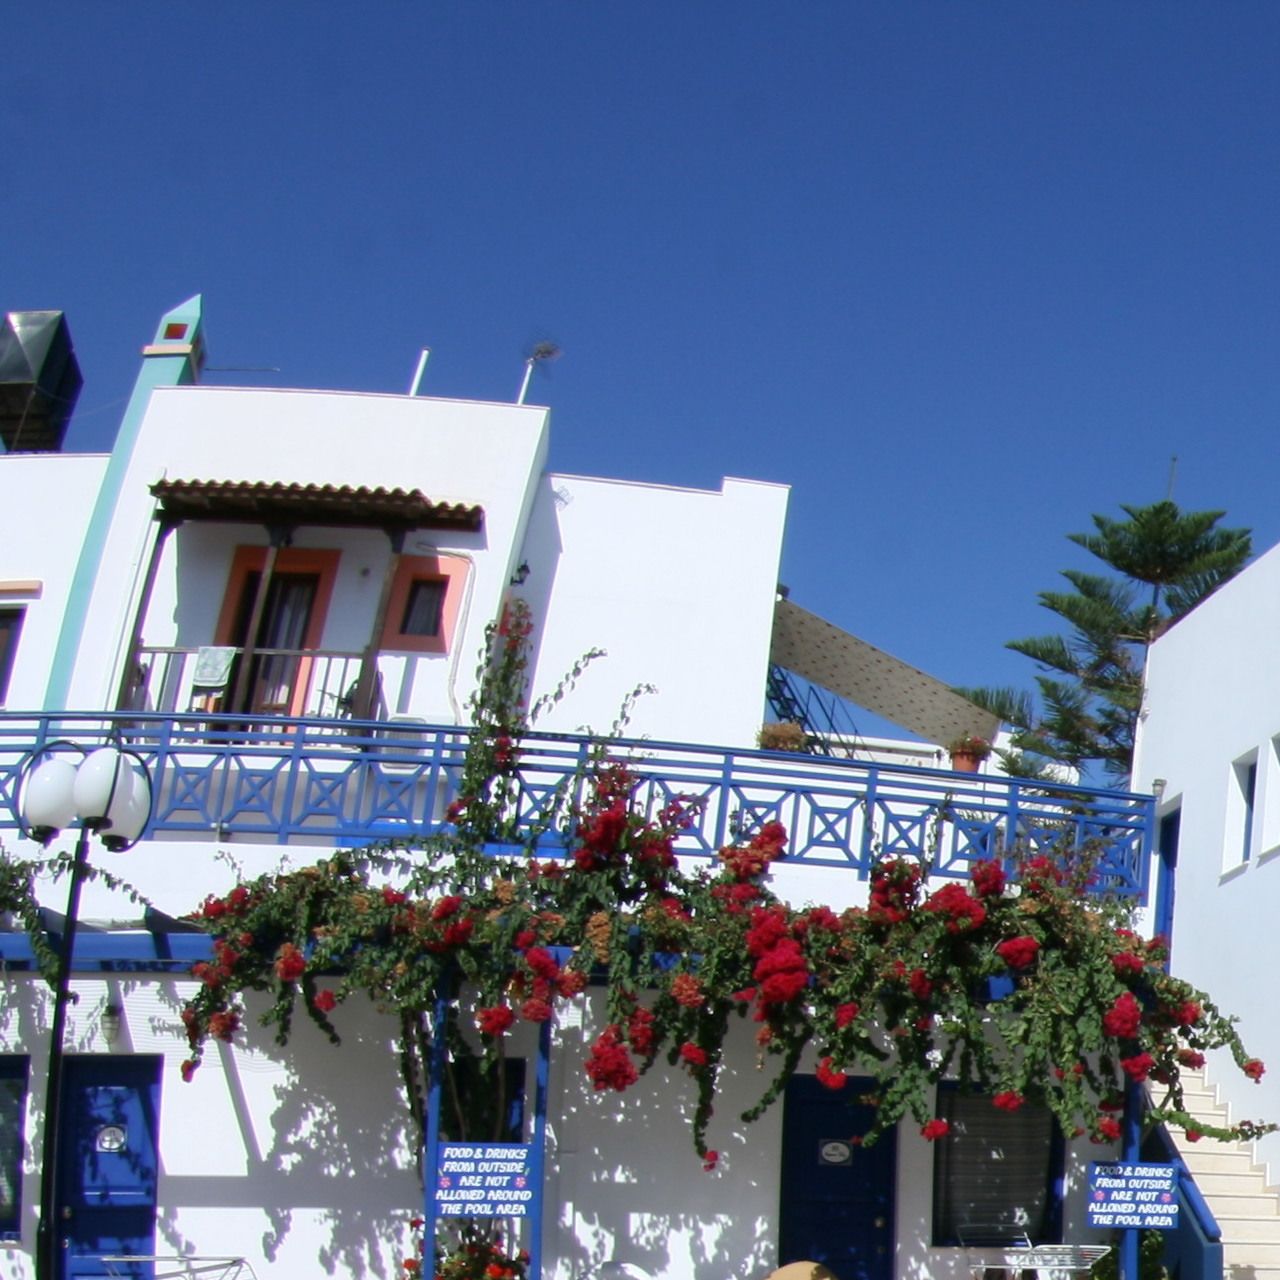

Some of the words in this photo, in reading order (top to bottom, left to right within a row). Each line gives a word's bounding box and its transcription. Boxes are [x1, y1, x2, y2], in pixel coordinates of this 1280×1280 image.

[444, 1147, 473, 1158] FOOD
[473, 1148, 482, 1158] &
[486, 1148, 527, 1159] DRINKS
[444, 1161, 474, 1172] FROM
[478, 1162, 524, 1172] OUTSIDE
[1123, 1166, 1132, 1176] &
[1135, 1167, 1173, 1177] DRINKS
[460, 1175, 482, 1186] ARE
[485, 1176, 510, 1186] NOT
[1096, 1177, 1125, 1188] FROM
[1129, 1179, 1171, 1189] OUTSIDE
[436, 1189, 485, 1200] ALLOWED
[488, 1190, 531, 1200] AROUND
[1111, 1191, 1133, 1200] ARE
[1136, 1191, 1158, 1201] NOT
[442, 1203, 462, 1214] THE
[465, 1203, 493, 1214] POOL
[497, 1203, 526, 1214] AREA
[1089, 1203, 1135, 1212] ALLOWED
[1138, 1204, 1178, 1213] AROUND
[1093, 1214, 1113, 1224] THE
[1116, 1215, 1142, 1224] POOL
[1145, 1216, 1172, 1225] AREA
